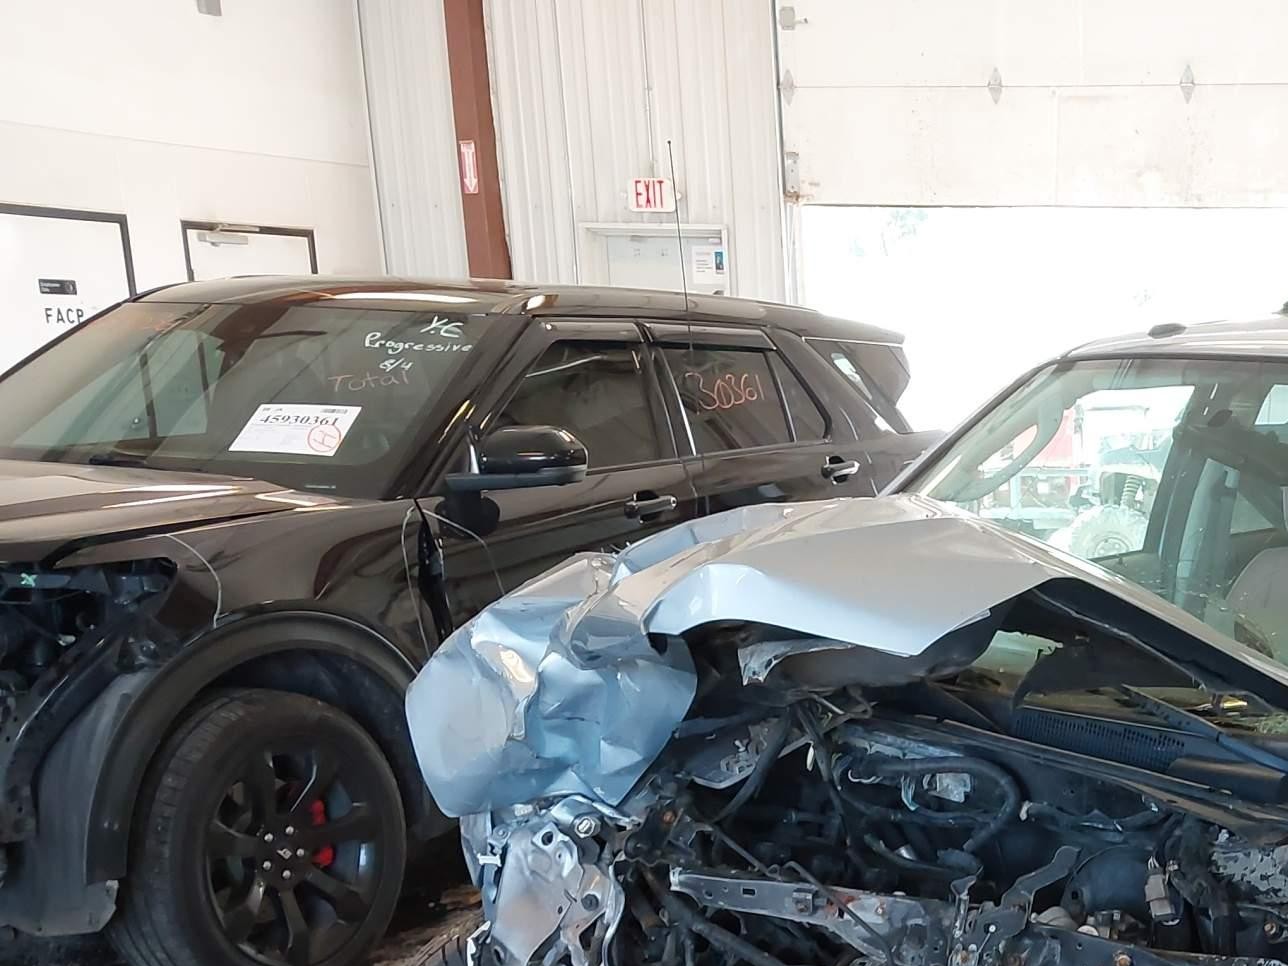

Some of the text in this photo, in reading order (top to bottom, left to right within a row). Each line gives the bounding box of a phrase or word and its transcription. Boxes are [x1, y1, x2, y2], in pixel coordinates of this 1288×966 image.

[634, 179, 664, 209] EXIT
[44, 307, 84, 324] FACP
[364, 331, 473, 355] Progressive
[328, 370, 409, 392] Total
[260, 414, 340, 426] 45930361
